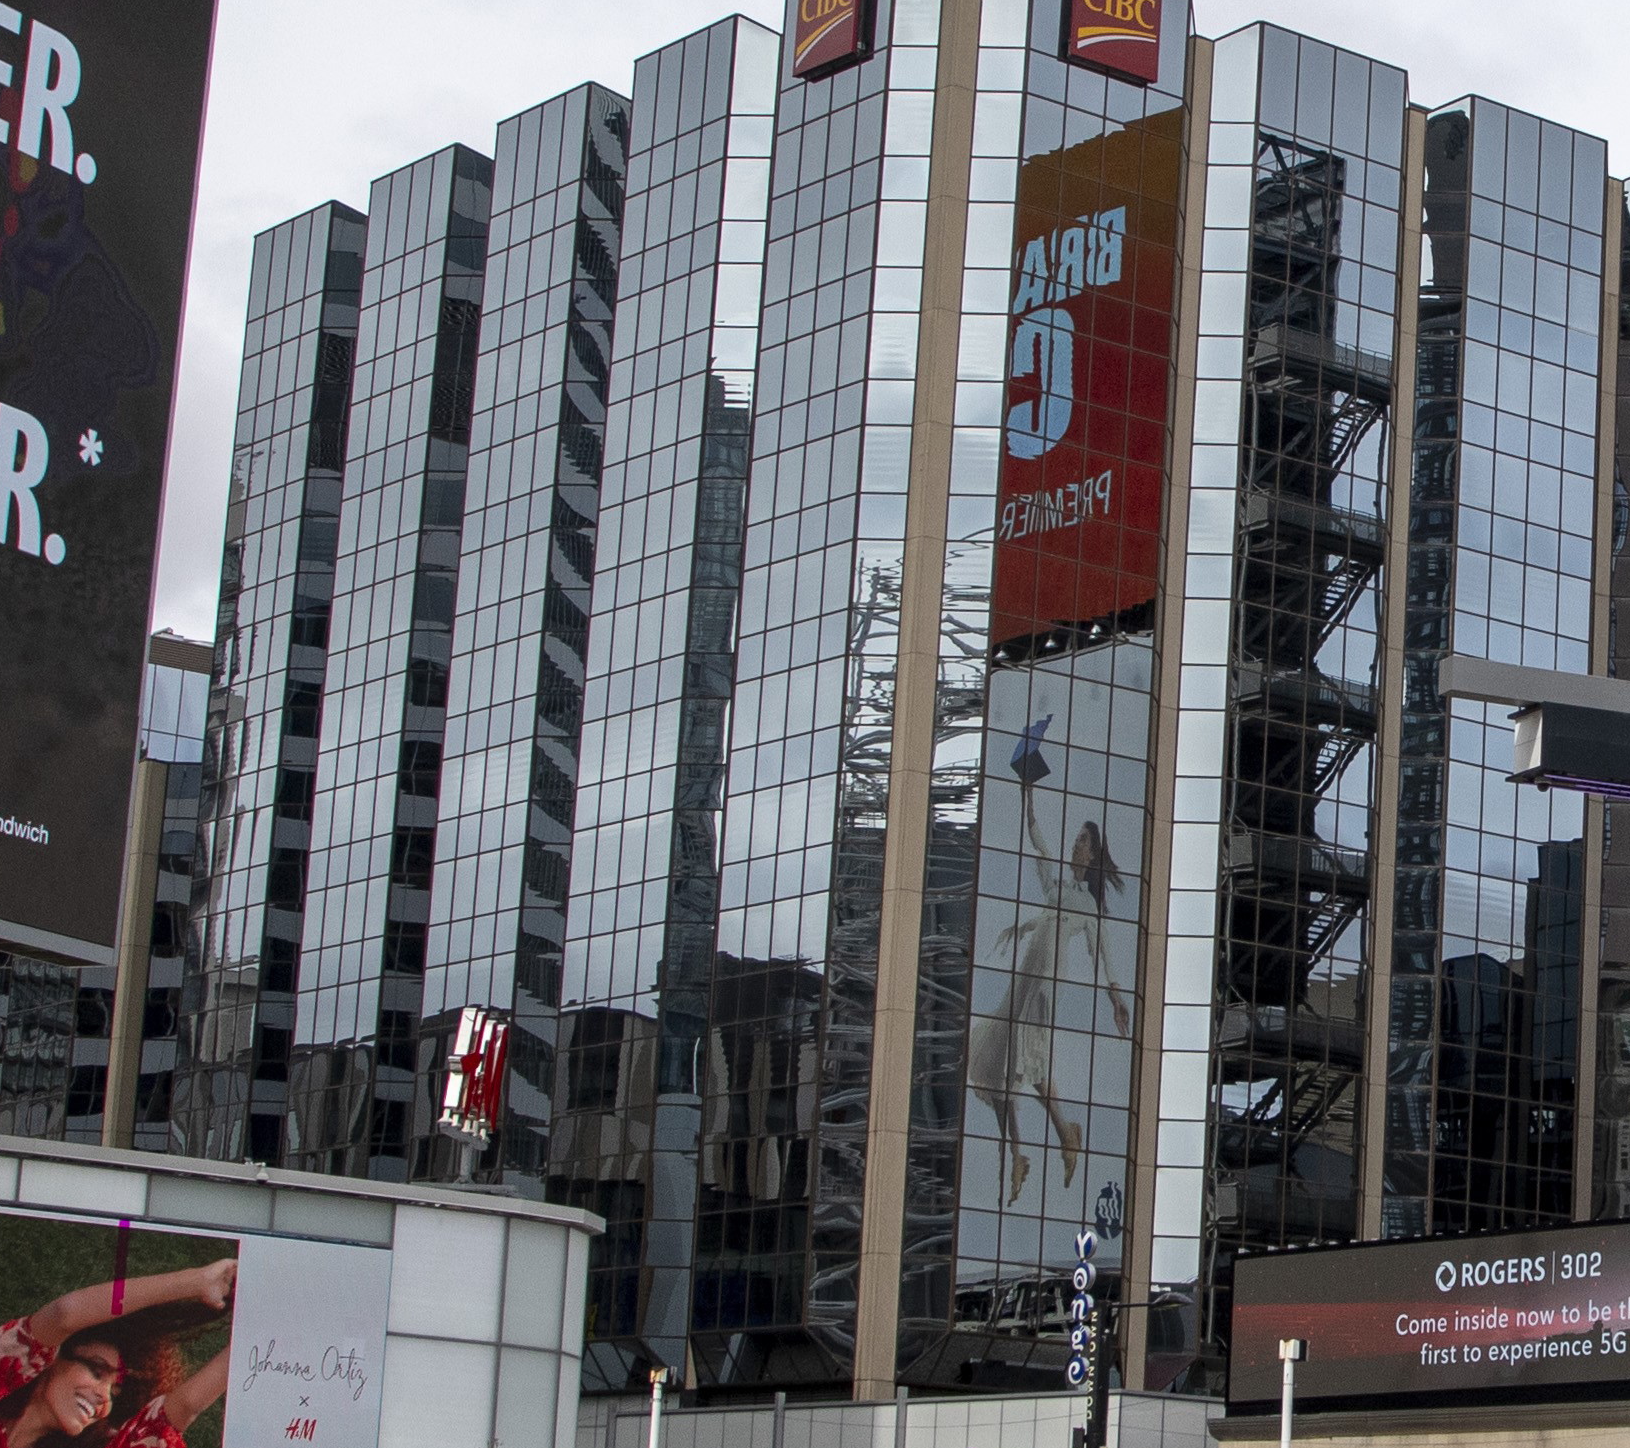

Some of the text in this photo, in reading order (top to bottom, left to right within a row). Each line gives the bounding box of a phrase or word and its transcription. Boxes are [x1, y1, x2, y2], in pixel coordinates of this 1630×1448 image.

[1461, 1251, 1602, 1288] ROGERS 302
[1068, 1230, 1098, 1386] Yonge
[1395, 1313, 1448, 1336] Come
[1453, 1306, 1510, 1332] inside
[1516, 1307, 1555, 1327] now
[1561, 1305, 1581, 1324] to
[1587, 1299, 1612, 1322] be
[1420, 1330, 1628, 1366] first to experience 5G
[243, 1339, 368, 1401] Johanna Ortiz
